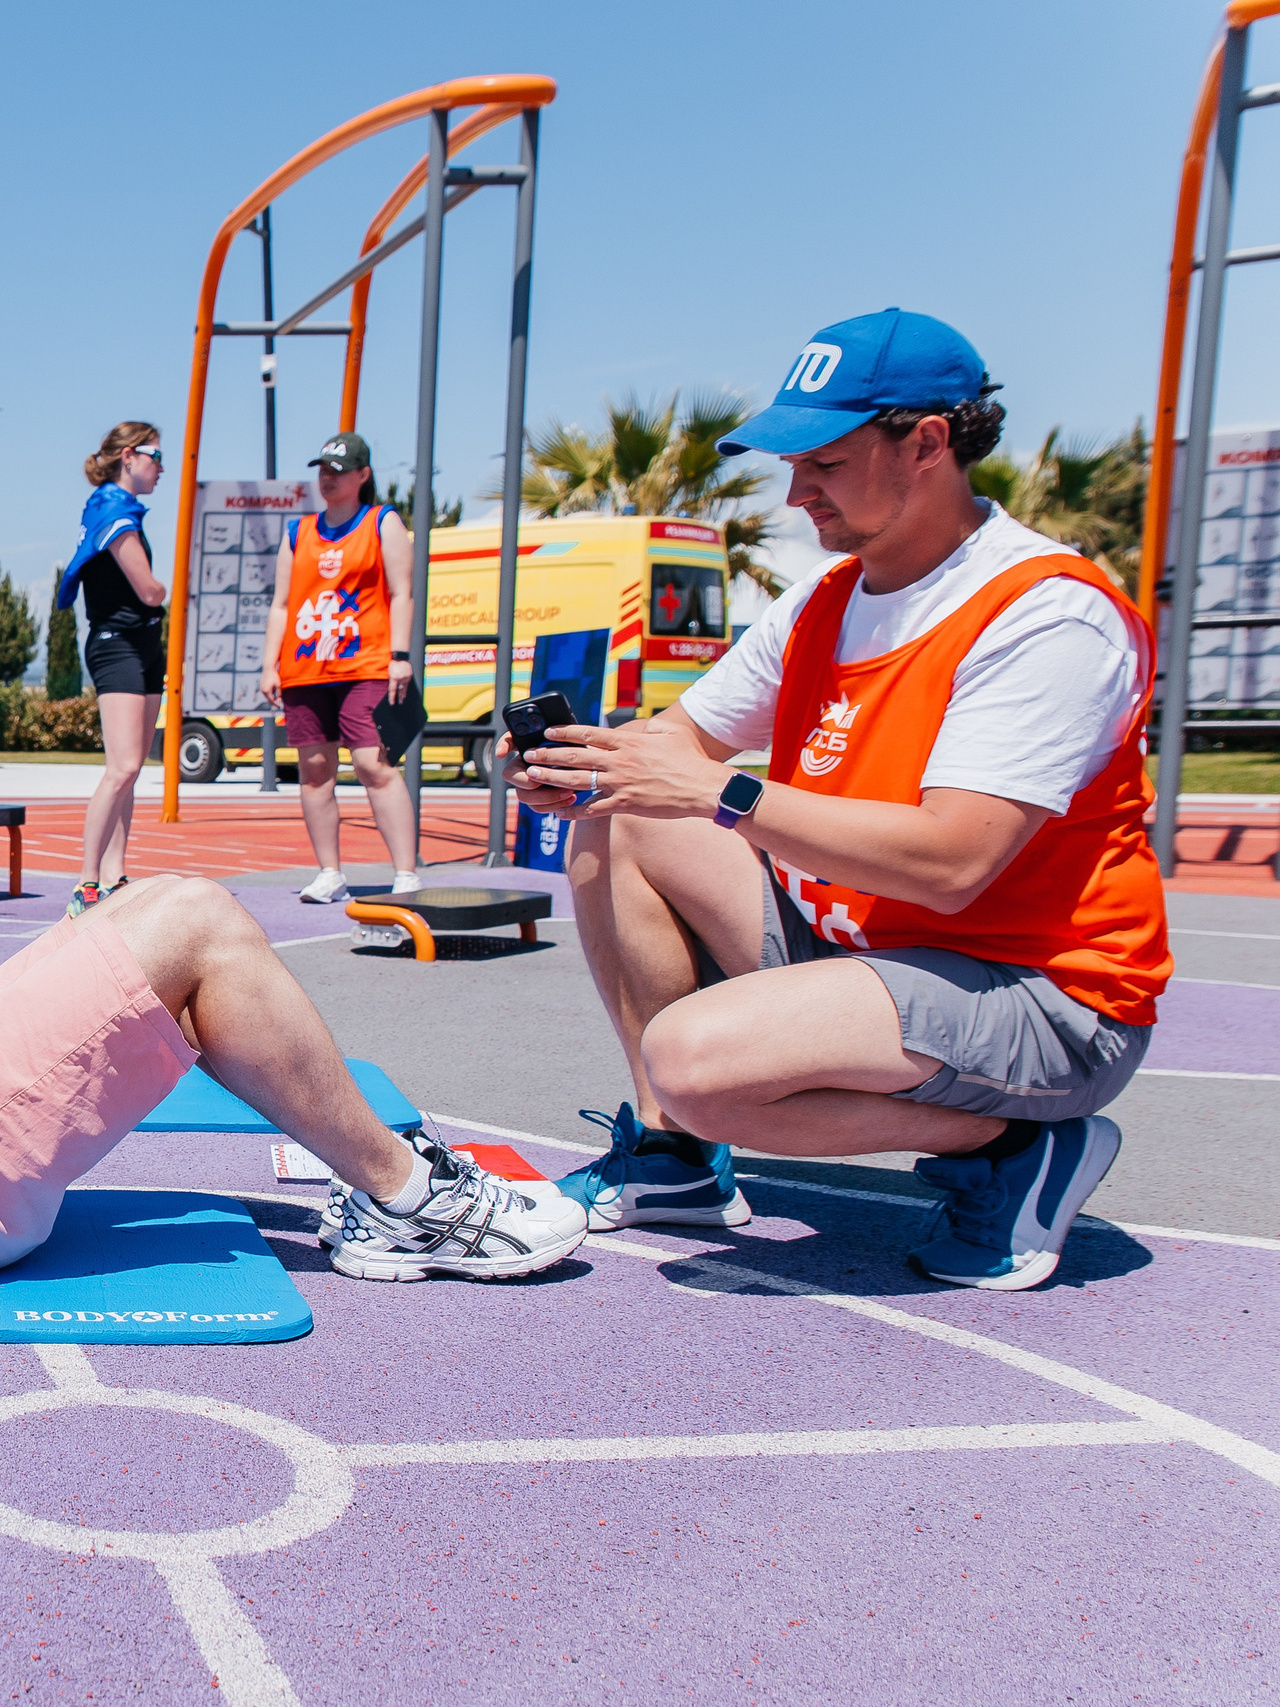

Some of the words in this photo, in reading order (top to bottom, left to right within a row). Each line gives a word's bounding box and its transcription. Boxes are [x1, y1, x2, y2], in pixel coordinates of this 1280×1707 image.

[225, 496, 293, 509] KOMPAN
[429, 592, 478, 609] SOCHI
[428, 611, 498, 628] MEDICAL
[514, 606, 561, 622] ROUP
[13, 1310, 135, 1323] BODY
